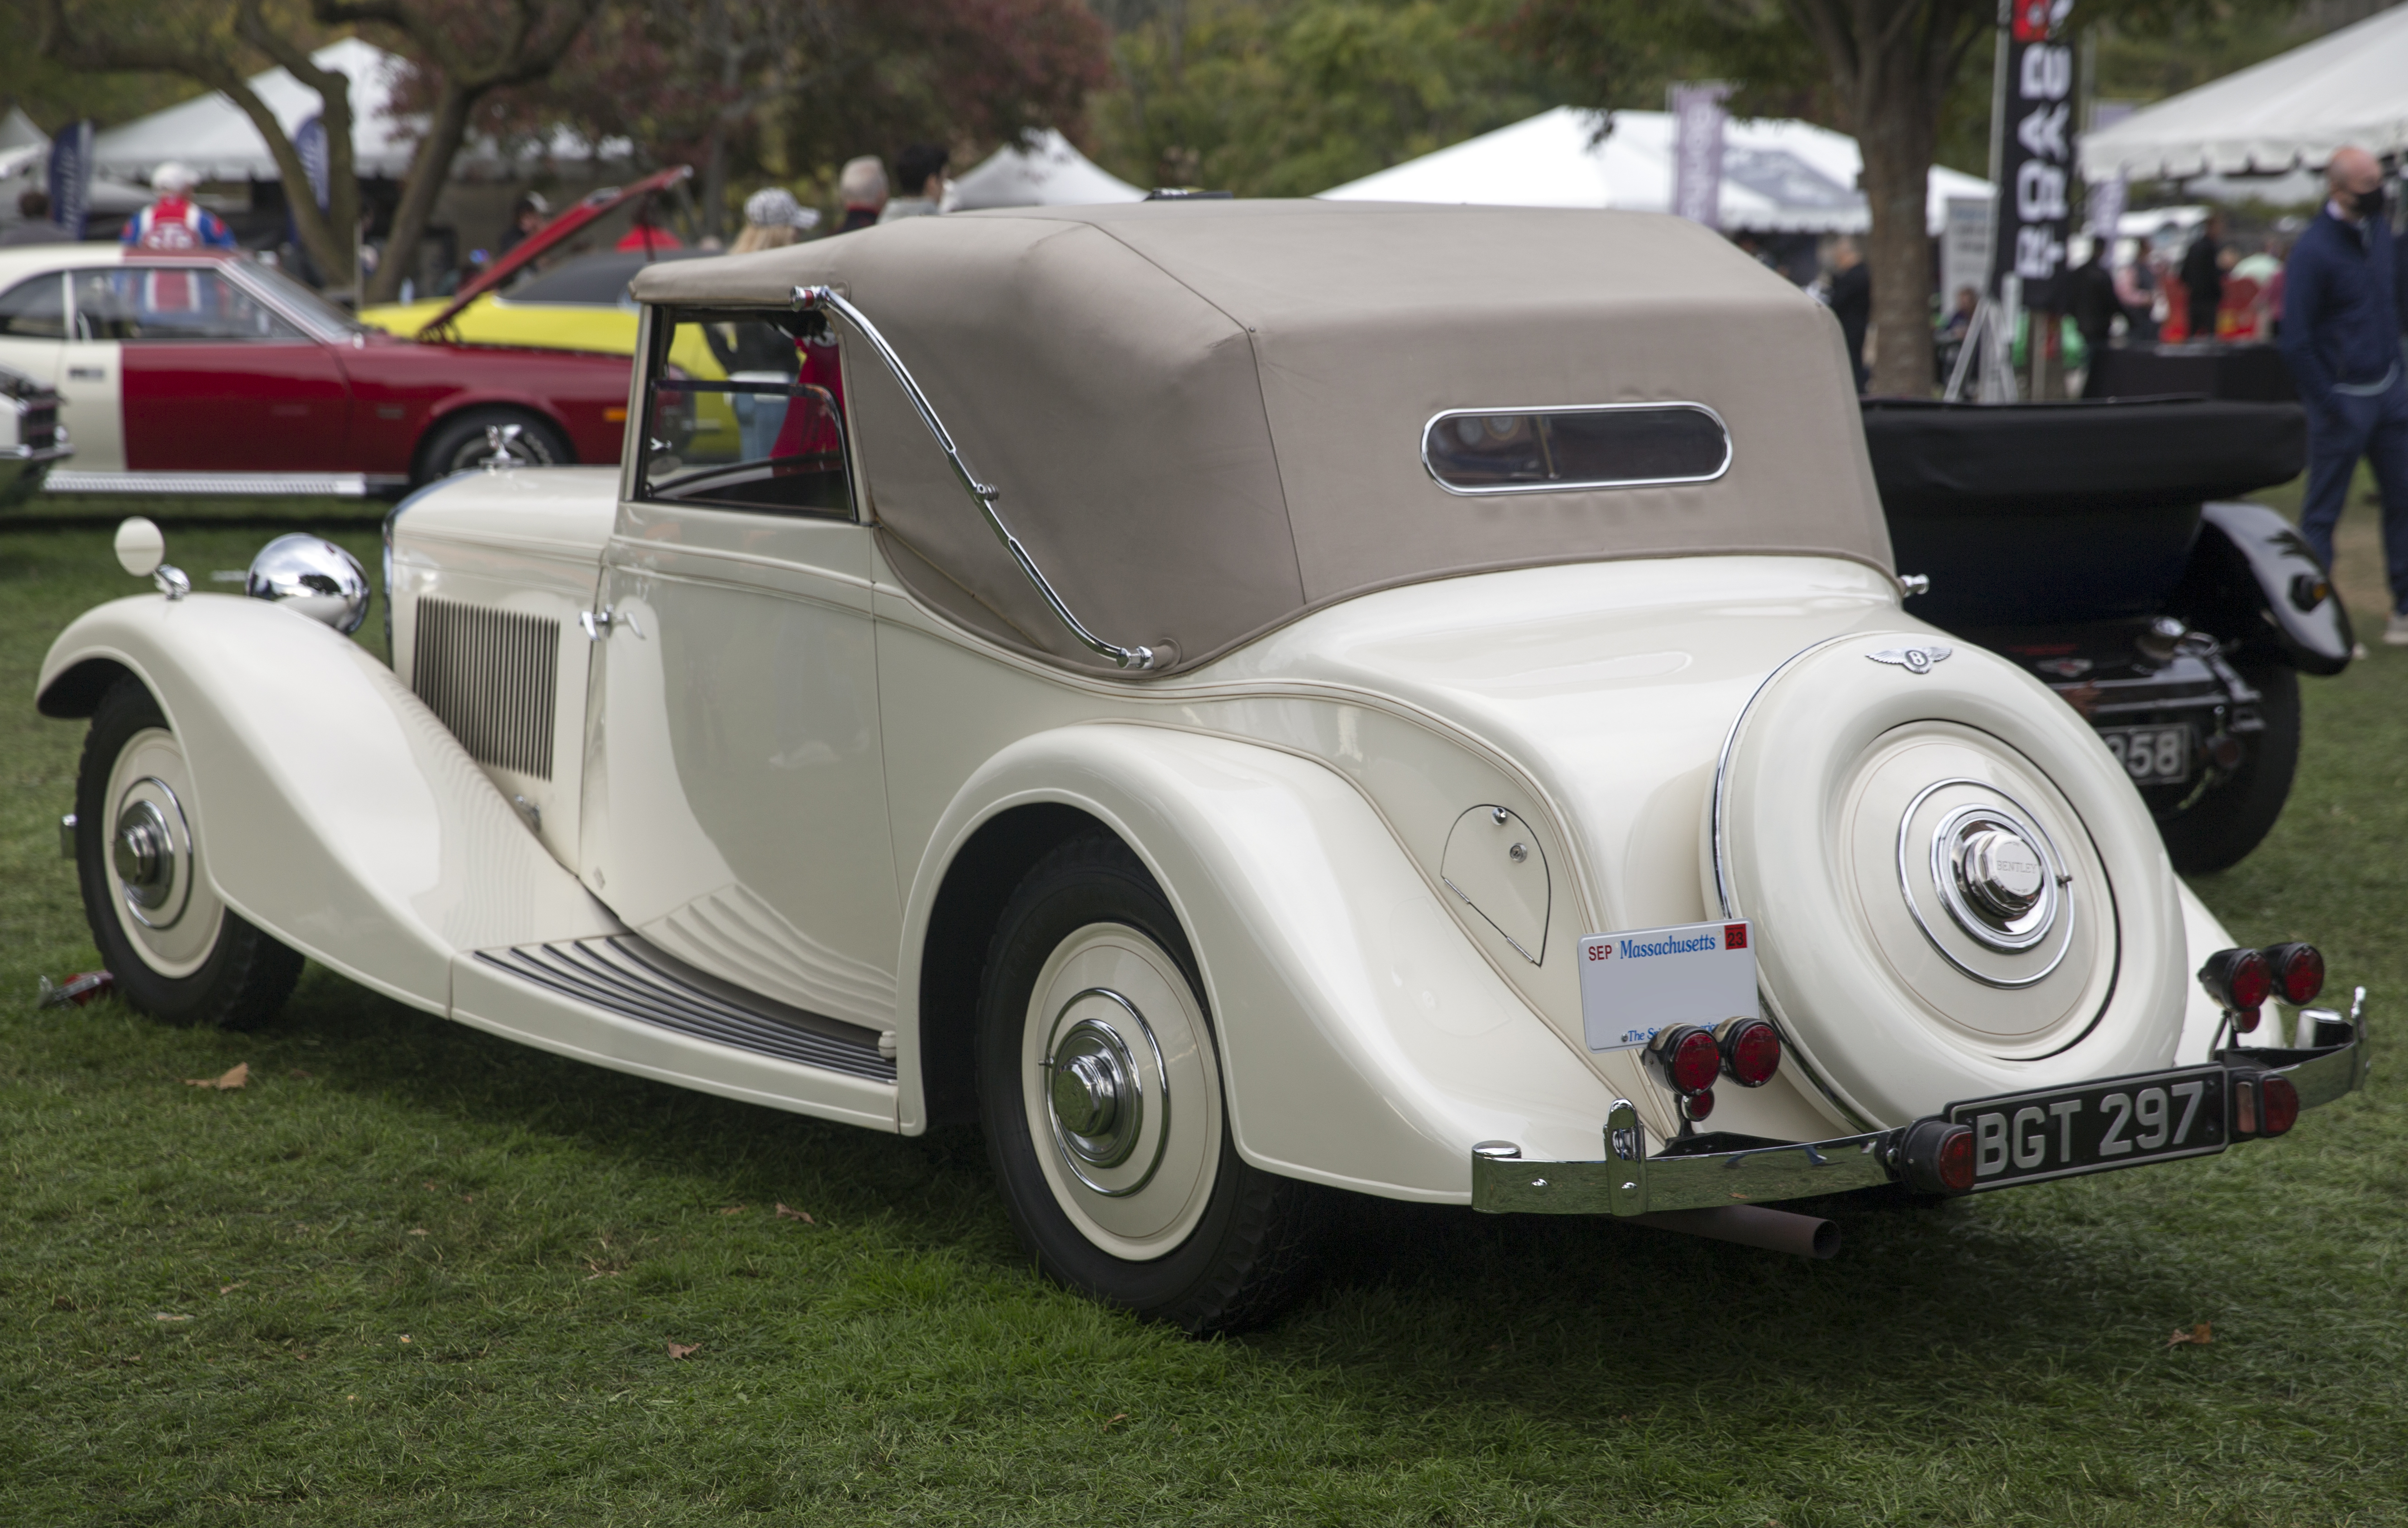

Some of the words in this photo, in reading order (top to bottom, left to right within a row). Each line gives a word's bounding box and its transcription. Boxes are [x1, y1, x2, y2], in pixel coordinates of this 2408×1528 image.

[1997, 861, 2038, 874] BENTLEY
[1727, 932, 1744, 946] 23
[1588, 945, 1612, 961] SEP
[1620, 934, 1715, 959] Massachusetts
[1628, 1030, 1645, 1041] The
[1976, 1099, 2081, 1177] BGT
[2099, 1081, 2203, 1156] 297
